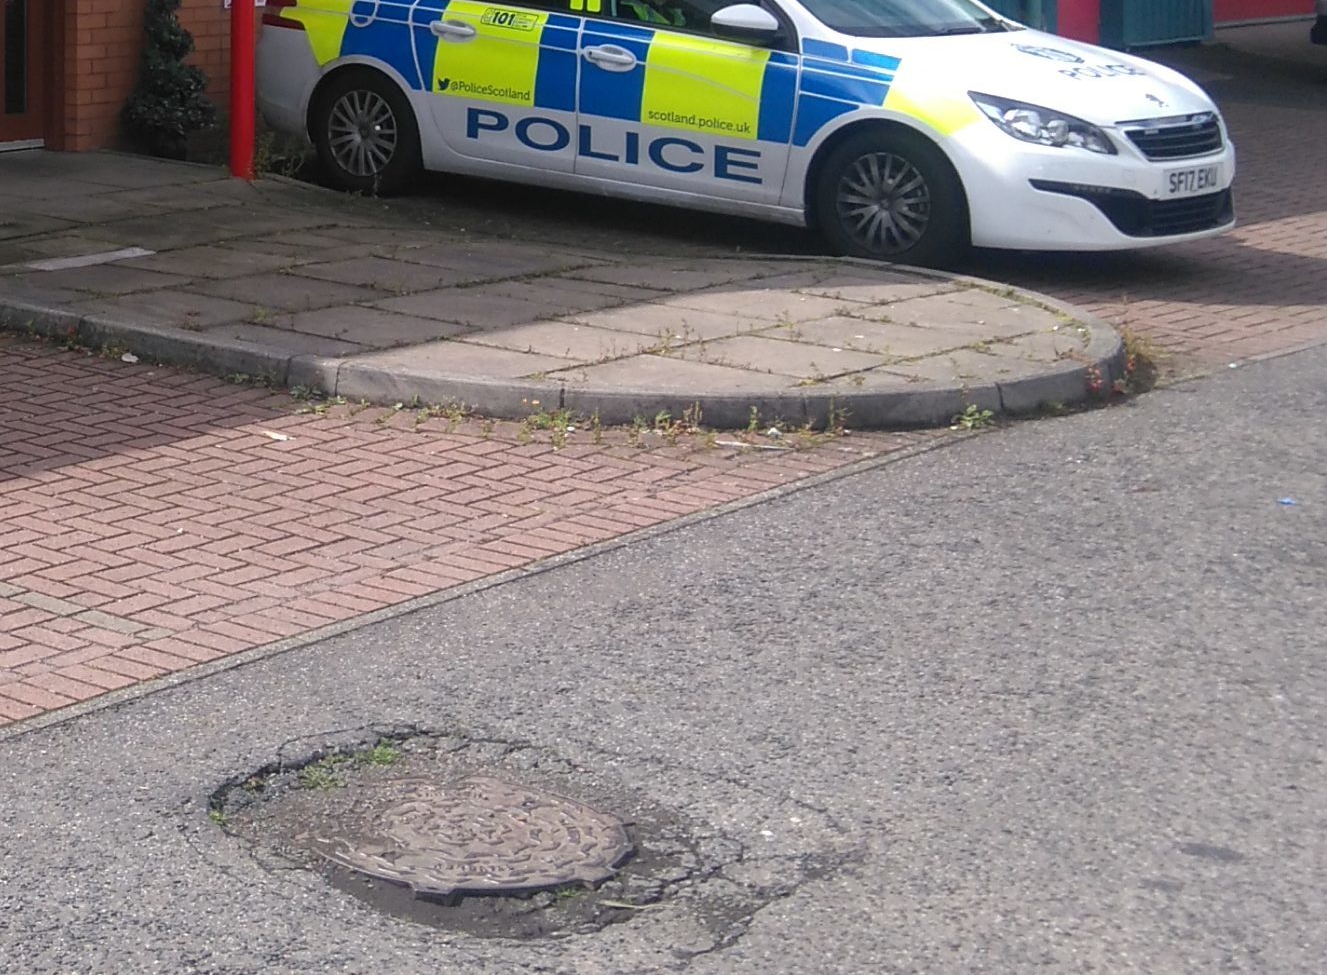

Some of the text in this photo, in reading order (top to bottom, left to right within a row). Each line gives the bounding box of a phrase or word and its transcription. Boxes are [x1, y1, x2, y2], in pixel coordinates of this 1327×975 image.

[492, 11, 515, 25] 101
[450, 80, 530, 102] @PoliceScotland
[648, 109, 751, 135] scotland.police.uk
[466, 107, 763, 185] POLICE
[1169, 168, 1218, 193] SF17 EKU
